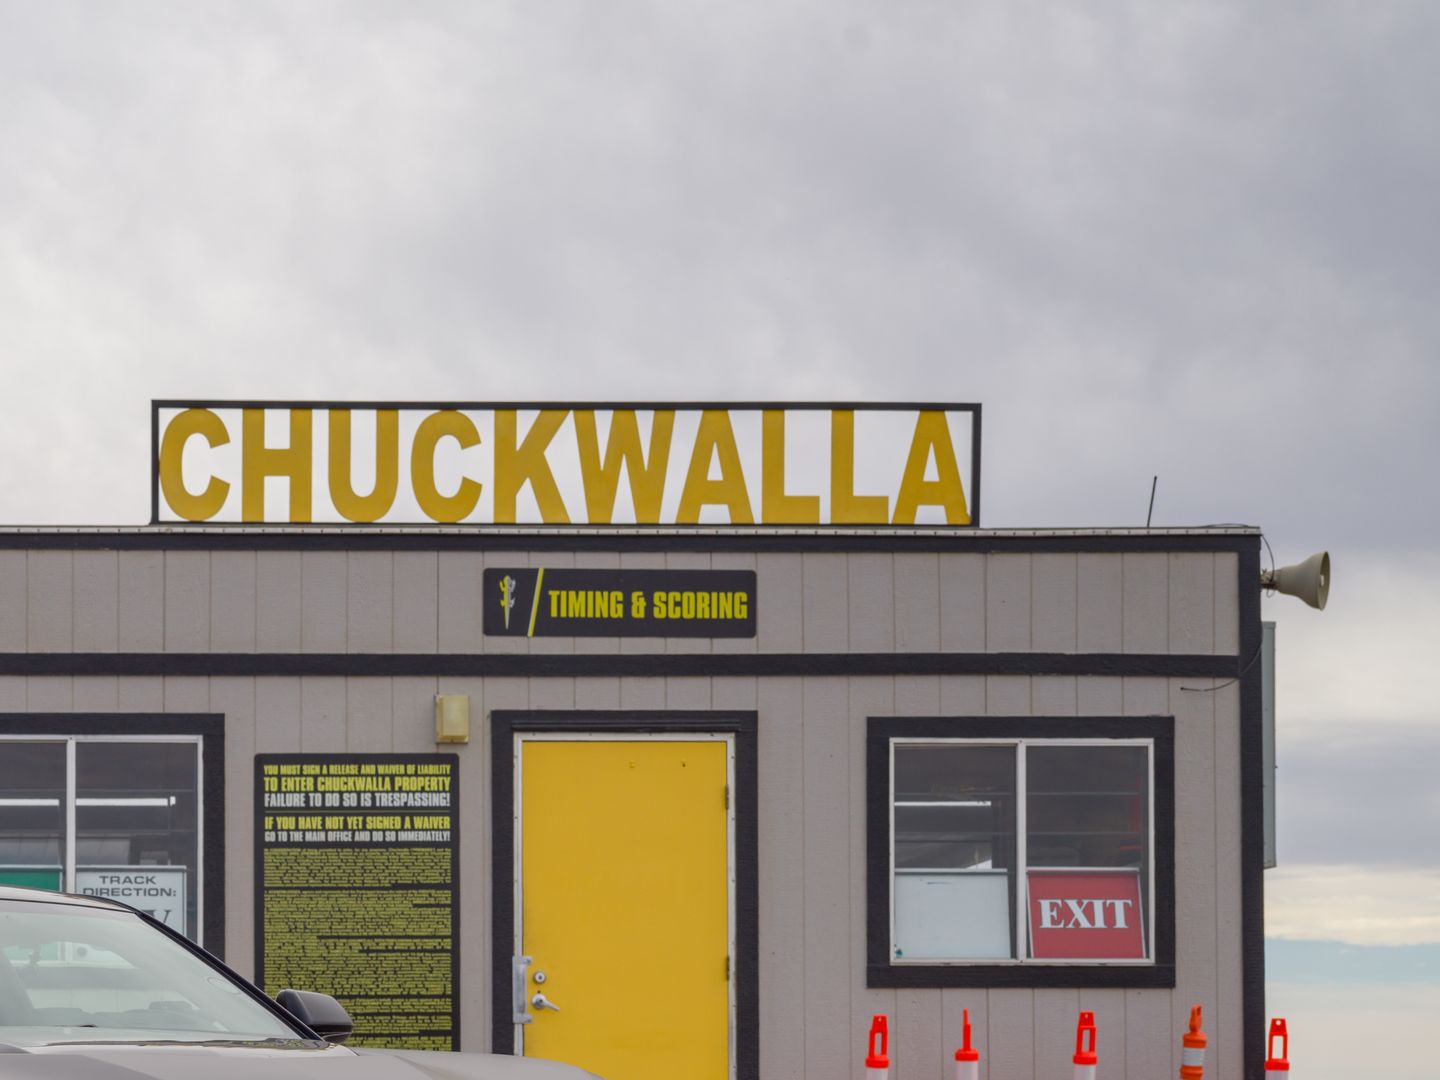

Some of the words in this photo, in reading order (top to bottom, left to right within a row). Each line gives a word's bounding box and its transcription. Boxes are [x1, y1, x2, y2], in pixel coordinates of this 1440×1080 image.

[159, 407, 971, 525] CHUCKWALLA
[548, 590, 623, 618] TIMING
[631, 591, 646, 619] &
[653, 591, 748, 619] SCORING
[264, 764, 279, 775] YOU
[280, 764, 300, 775] MUST
[302, 764, 320, 775] SIGN
[322, 764, 328, 775] A
[329, 764, 359, 775] RELEASE
[361, 764, 376, 775] AND
[377, 764, 405, 775] WAIVER
[406, 764, 415, 775] OF
[417, 764, 451, 775] LIABILITY
[264, 776, 278, 792] TO
[281, 776, 314, 792] ENTER
[317, 776, 391, 792] CHUCKWALLA
[394, 776, 451, 792] PROPERTY
[264, 792, 306, 807] FAILURE
[308, 792, 322, 807] TO
[325, 792, 340, 807] DO
[343, 792, 357, 807] SO
[360, 792, 372, 807] IS
[375, 792, 450, 807] TRESPASSING!
[264, 816, 274, 830] IF
[276, 816, 296, 830] YOU
[298, 816, 323, 830] HAVE
[325, 816, 344, 830] NOT
[346, 816, 364, 830] YET
[366, 816, 401, 830] SIGNED
[404, 816, 411, 830] A
[413, 816, 450, 830] WAIVER
[264, 831, 276, 842] GO
[278, 831, 288, 842] TO
[289, 831, 303, 842] THE
[305, 831, 326, 842] MAIN
[327, 831, 352, 842] OFFICE
[354, 831, 371, 842] AND
[372, 831, 383, 842] DO
[385, 831, 396, 842] SO
[398, 831, 450, 842] IMMEDIATELY!
[100, 876, 156, 884] TRACK
[83, 888, 176, 896] DIRECTION:
[1038, 899, 1132, 928] EXIT
